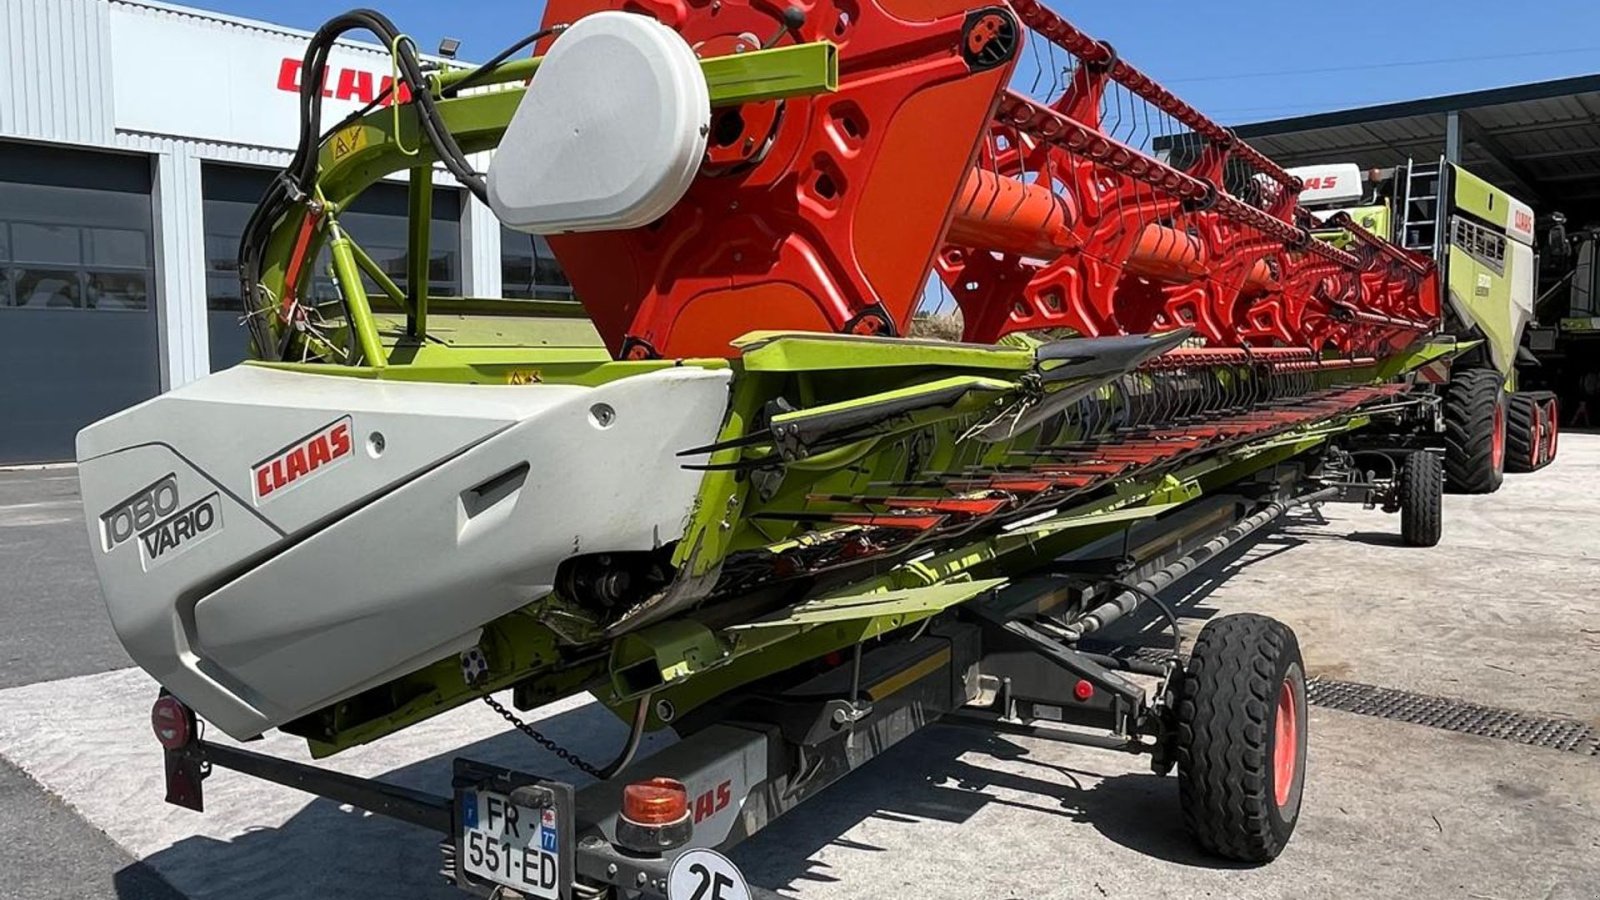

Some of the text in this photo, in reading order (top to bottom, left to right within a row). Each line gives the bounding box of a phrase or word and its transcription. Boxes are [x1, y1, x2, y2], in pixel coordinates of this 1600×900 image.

[258, 424, 350, 496] CLAAS
[103, 480, 179, 550] 1080
[143, 503, 214, 559] VARIO
[470, 831, 556, 890] 551-ED
[543, 831, 556, 848] 77
